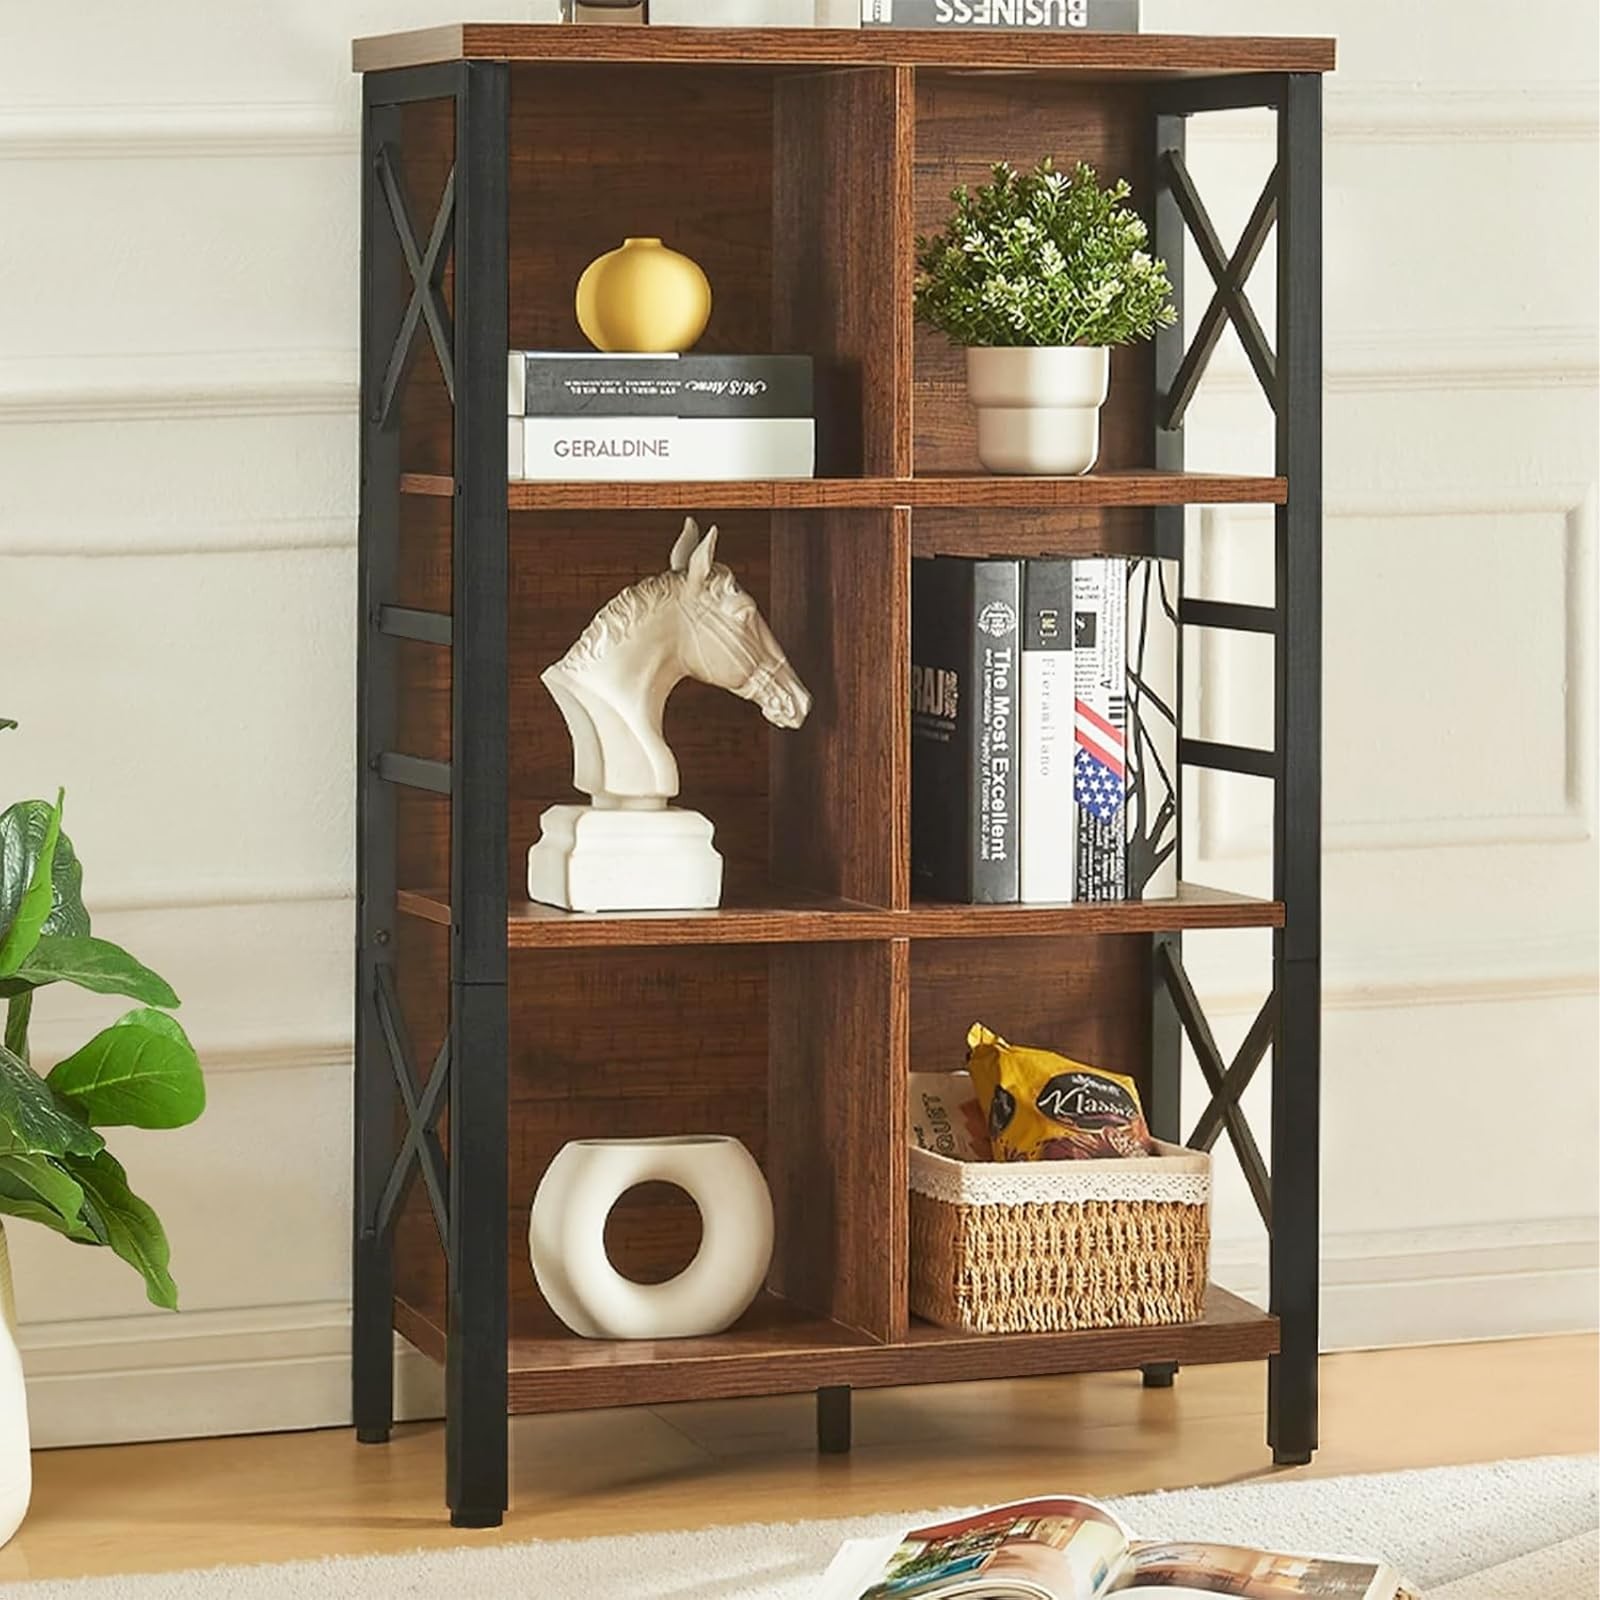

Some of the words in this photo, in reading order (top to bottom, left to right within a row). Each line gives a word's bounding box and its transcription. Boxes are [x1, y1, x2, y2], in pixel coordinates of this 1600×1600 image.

[935, 0, 1088, 27] BUSINESS
[553, 439, 670, 458] GERALDINE
[993, 647, 1011, 690] The
[992, 695, 1011, 752] Most
[991, 757, 1010, 861] Excellent
